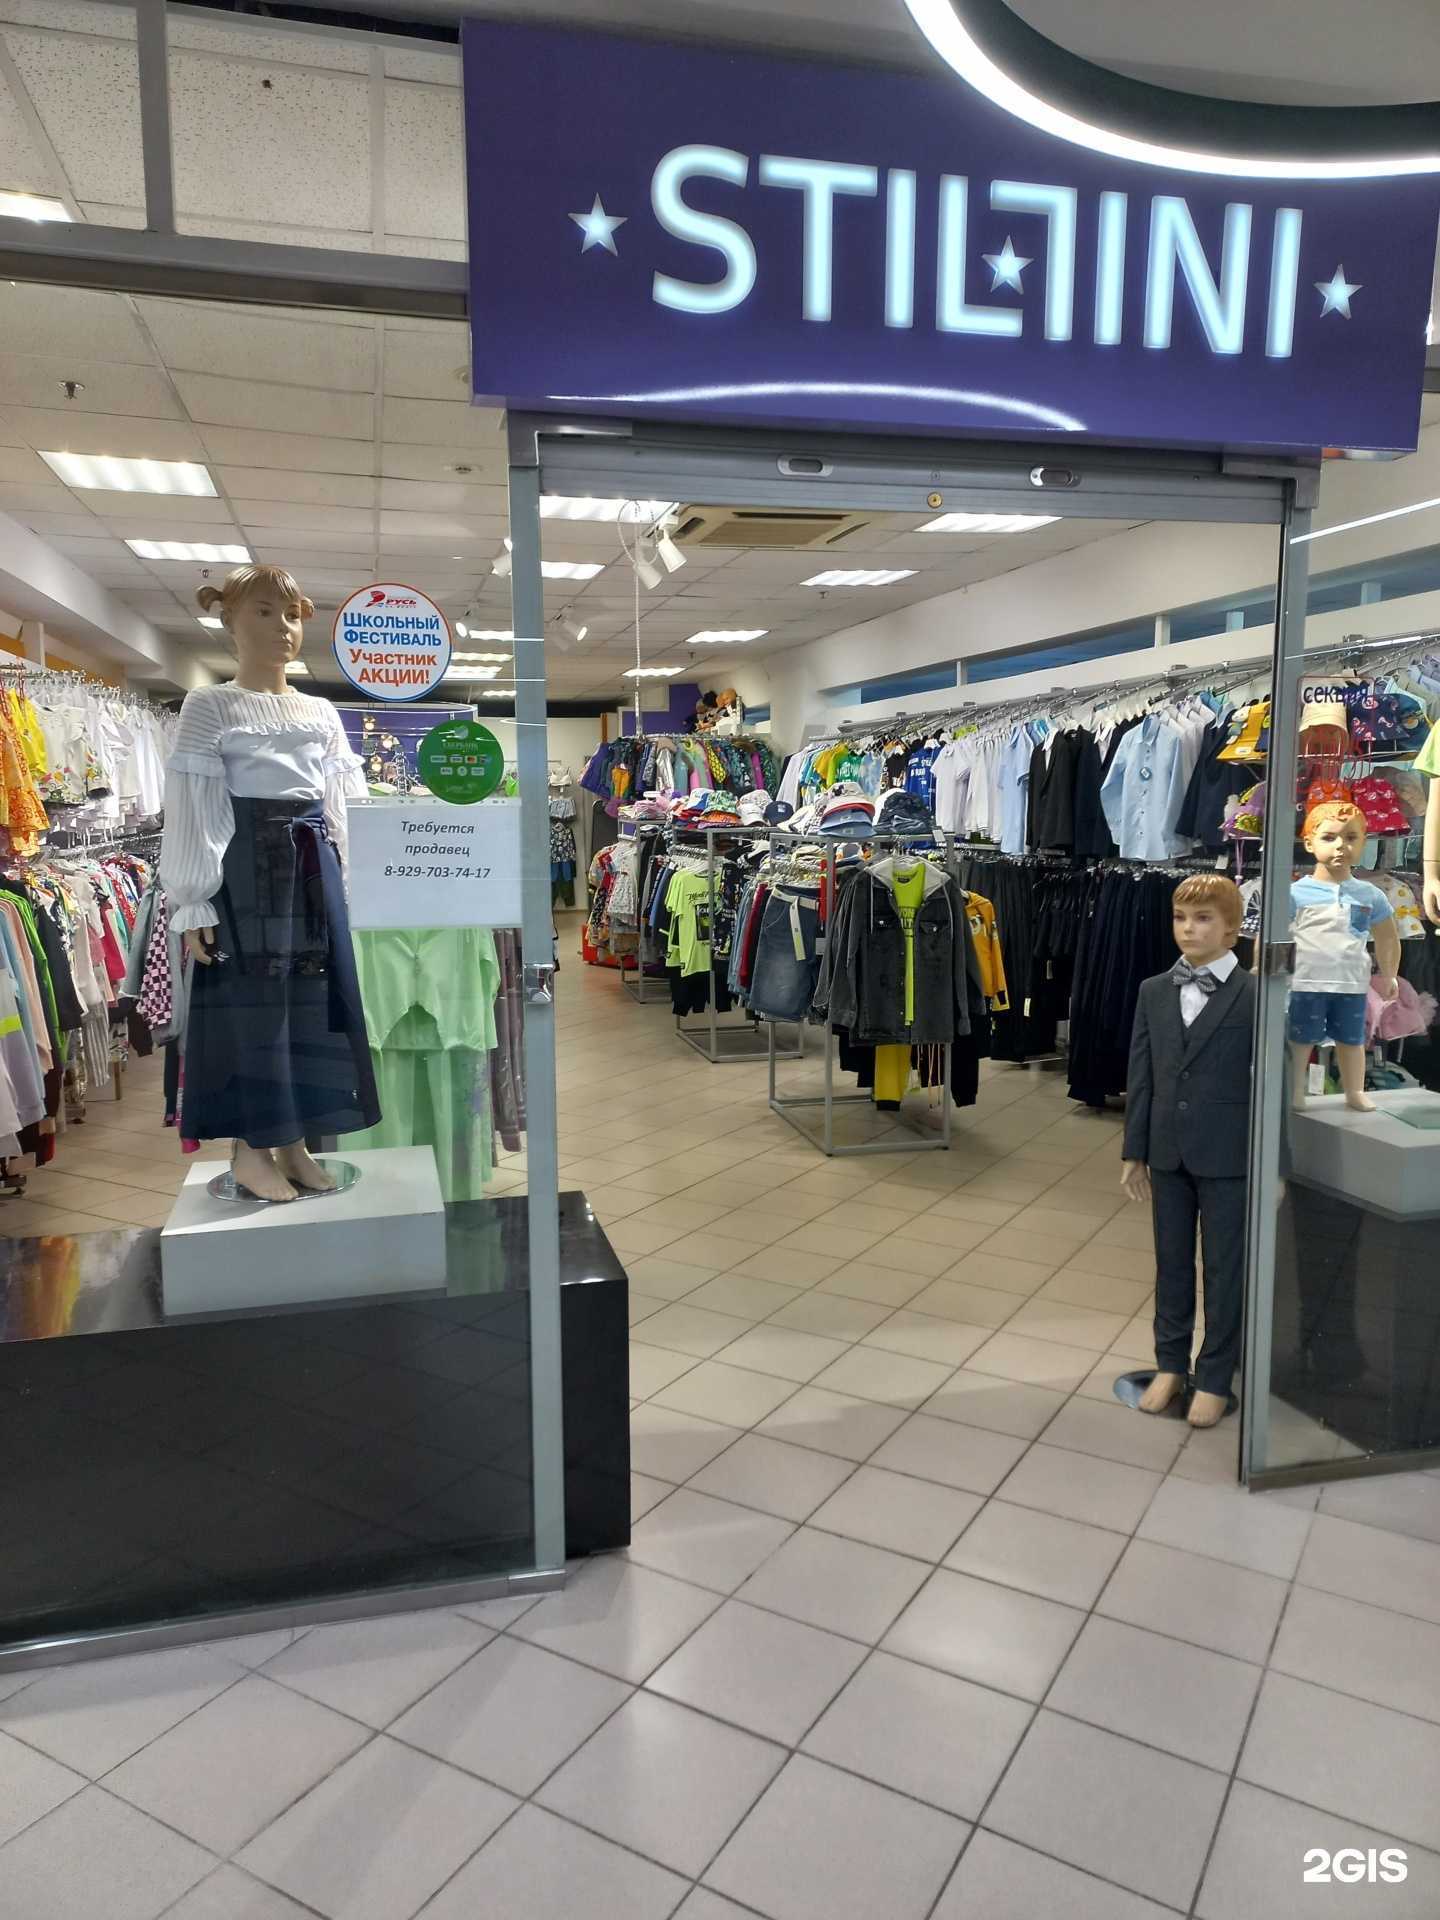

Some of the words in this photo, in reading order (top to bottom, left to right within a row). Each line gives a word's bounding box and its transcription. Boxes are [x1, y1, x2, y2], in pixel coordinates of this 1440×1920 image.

[343, 631, 442, 647] ФЕСТИВАЛЬ
[358, 668, 430, 687] АКЦИИ!
[401, 820, 475, 835] Требуется
[405, 843, 470, 857] продавец
[384, 865, 491, 879] 8-929-703-74-17
